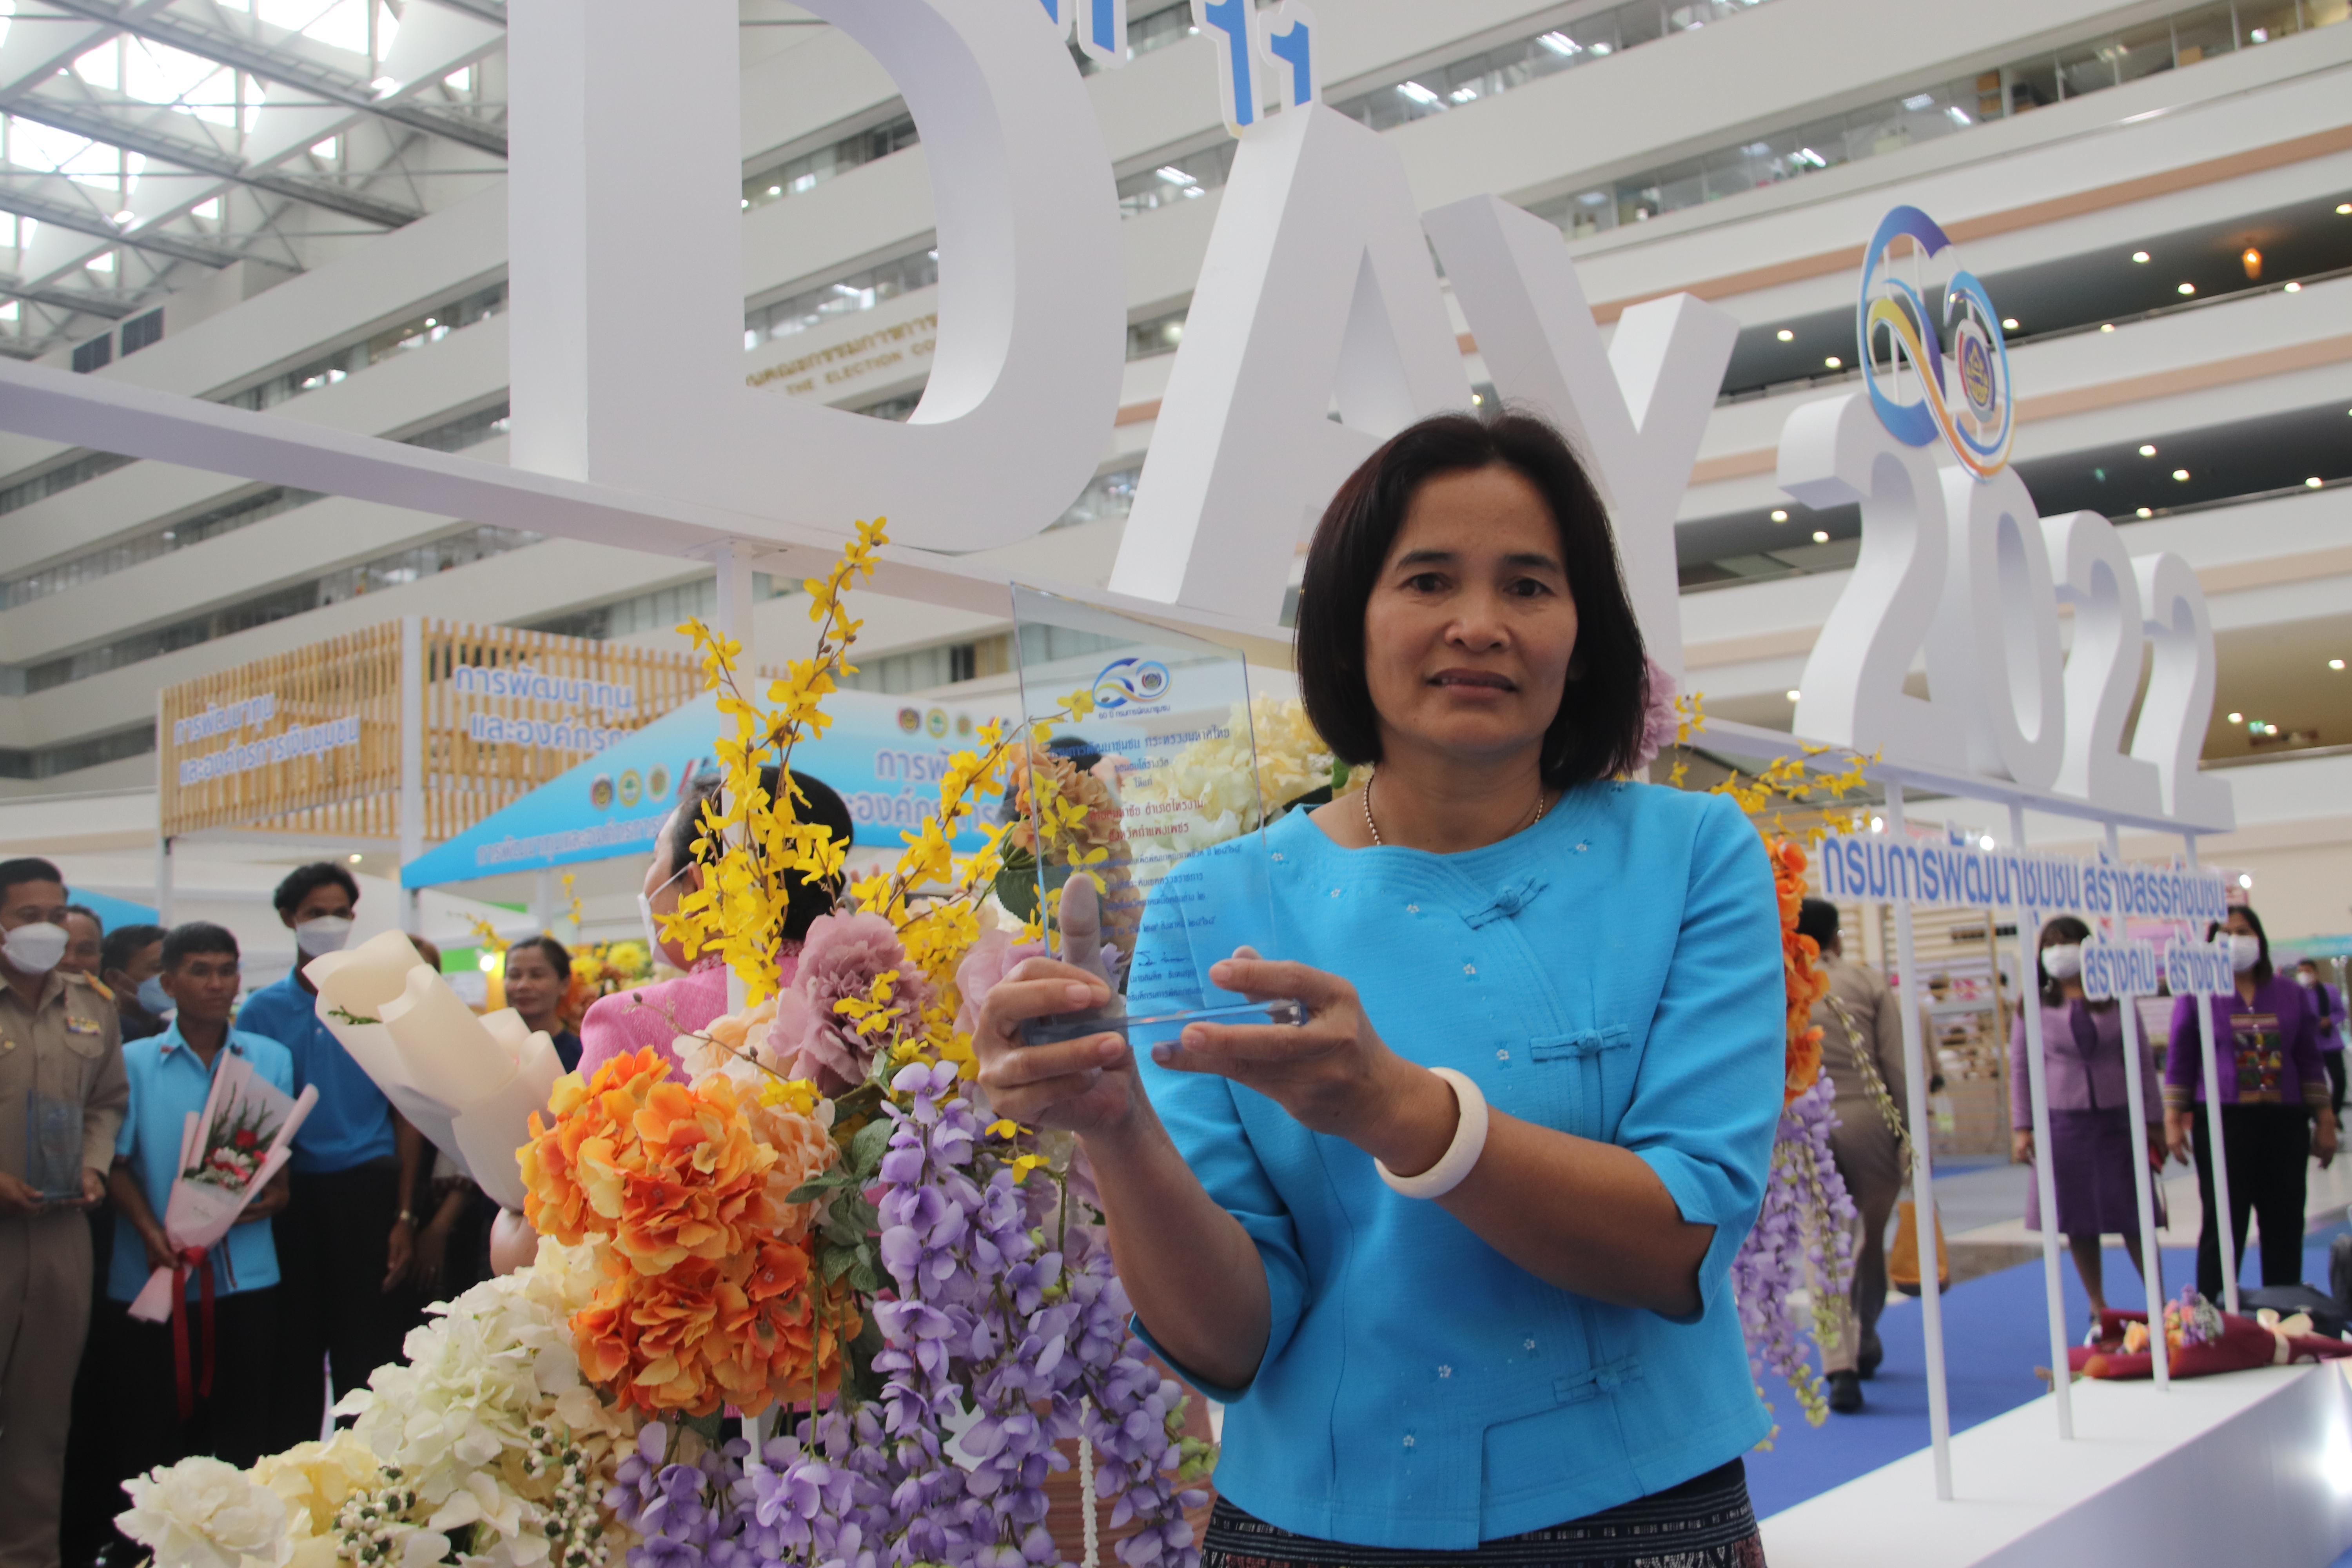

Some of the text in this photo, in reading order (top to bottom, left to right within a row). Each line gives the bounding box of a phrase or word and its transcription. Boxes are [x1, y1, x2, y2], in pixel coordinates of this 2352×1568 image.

[509, 0, 1740, 688] DAY
[786, 378, 813, 396] THE
[825, 350, 903, 384] ELECTION
[1778, 392, 2236, 832] 2022
[456, 666, 631, 716] การพัฒนาทุน
[175, 695, 274, 744] การพัฒนาทุน
[472, 715, 636, 751] และองค์กรก
[1145, 725, 1230, 747] กระทรวงมหาดไทย
[180, 715, 359, 784] และองค์กรการเงินชุมชน
[1134, 777, 1152, 788] ให้แก่
[1145, 798, 1204, 815] อำเภอไทรงาม
[1109, 822, 1189, 840] จังหวัดกำแพงเพชร
[1824, 830, 2226, 932] กรมการพัฒนาชุมชน สร้างสรรค์ชุมชน
[2084, 930, 2232, 994] สร้างคน สร้างชาติ
